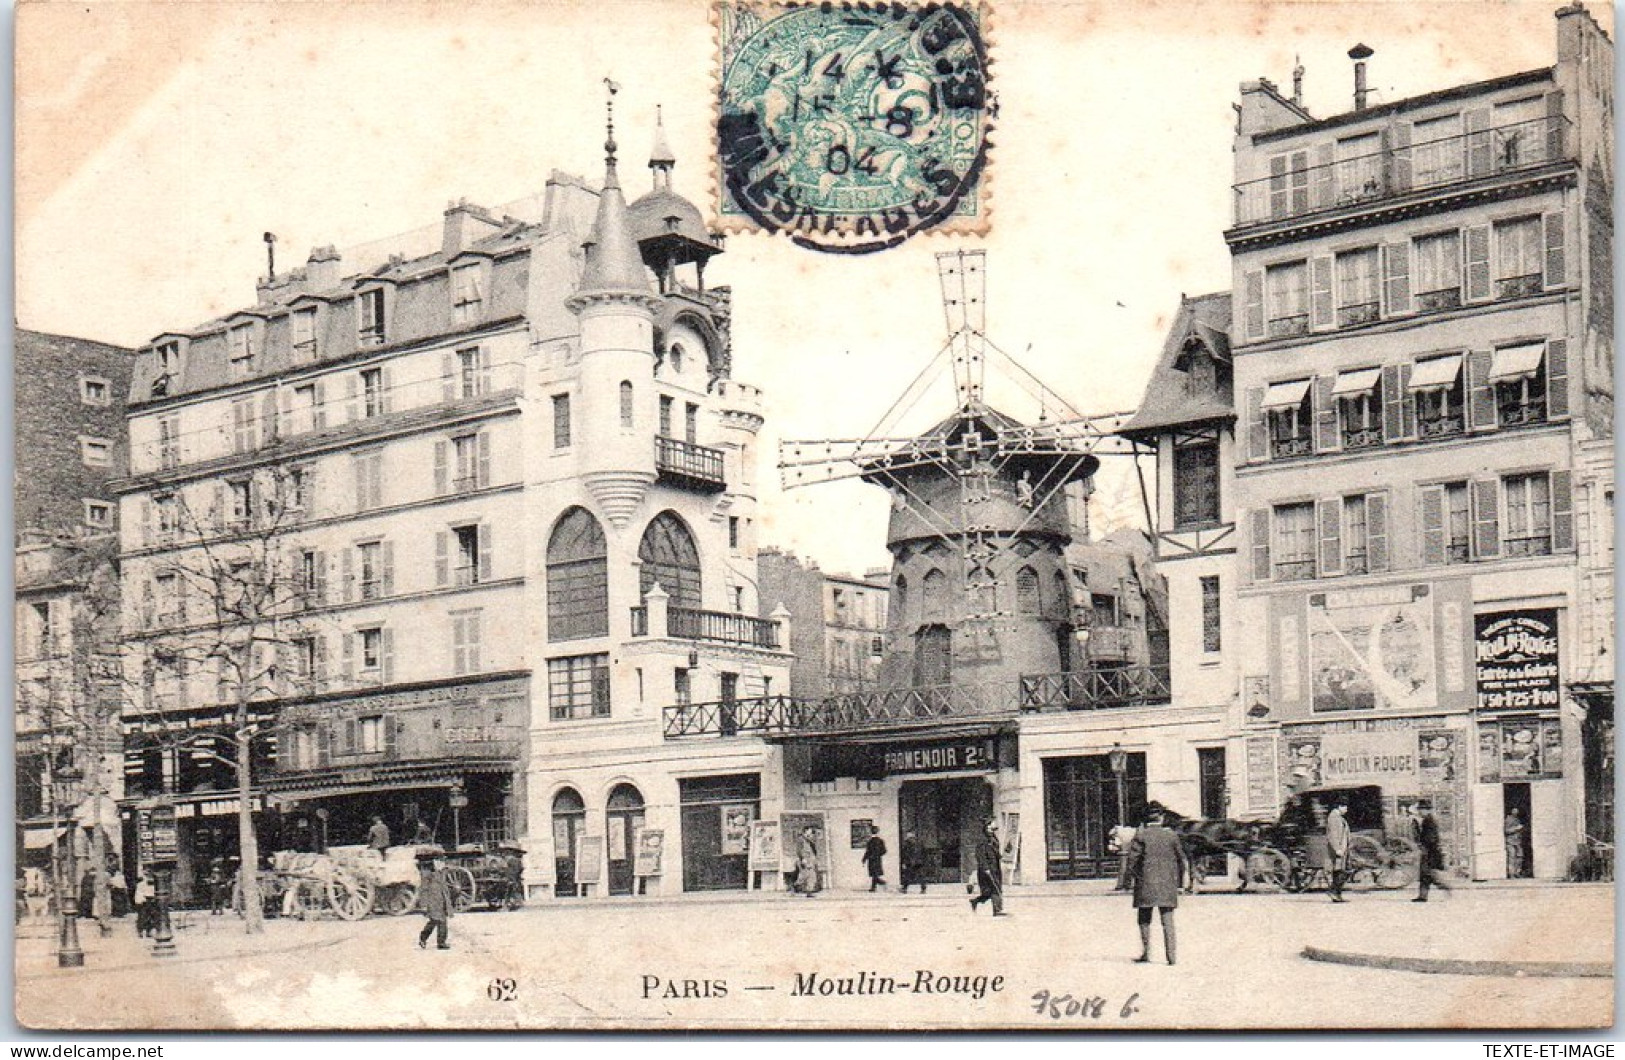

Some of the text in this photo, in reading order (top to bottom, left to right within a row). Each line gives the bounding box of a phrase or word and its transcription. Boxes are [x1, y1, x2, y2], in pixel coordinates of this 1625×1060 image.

[884, 747, 957, 771] PROMENOIR
[1328, 755, 1412, 774] MOULIN ROUGE
[487, 980, 517, 1002] 62
[791, 970, 1006, 1000] Moulin-Rouge
